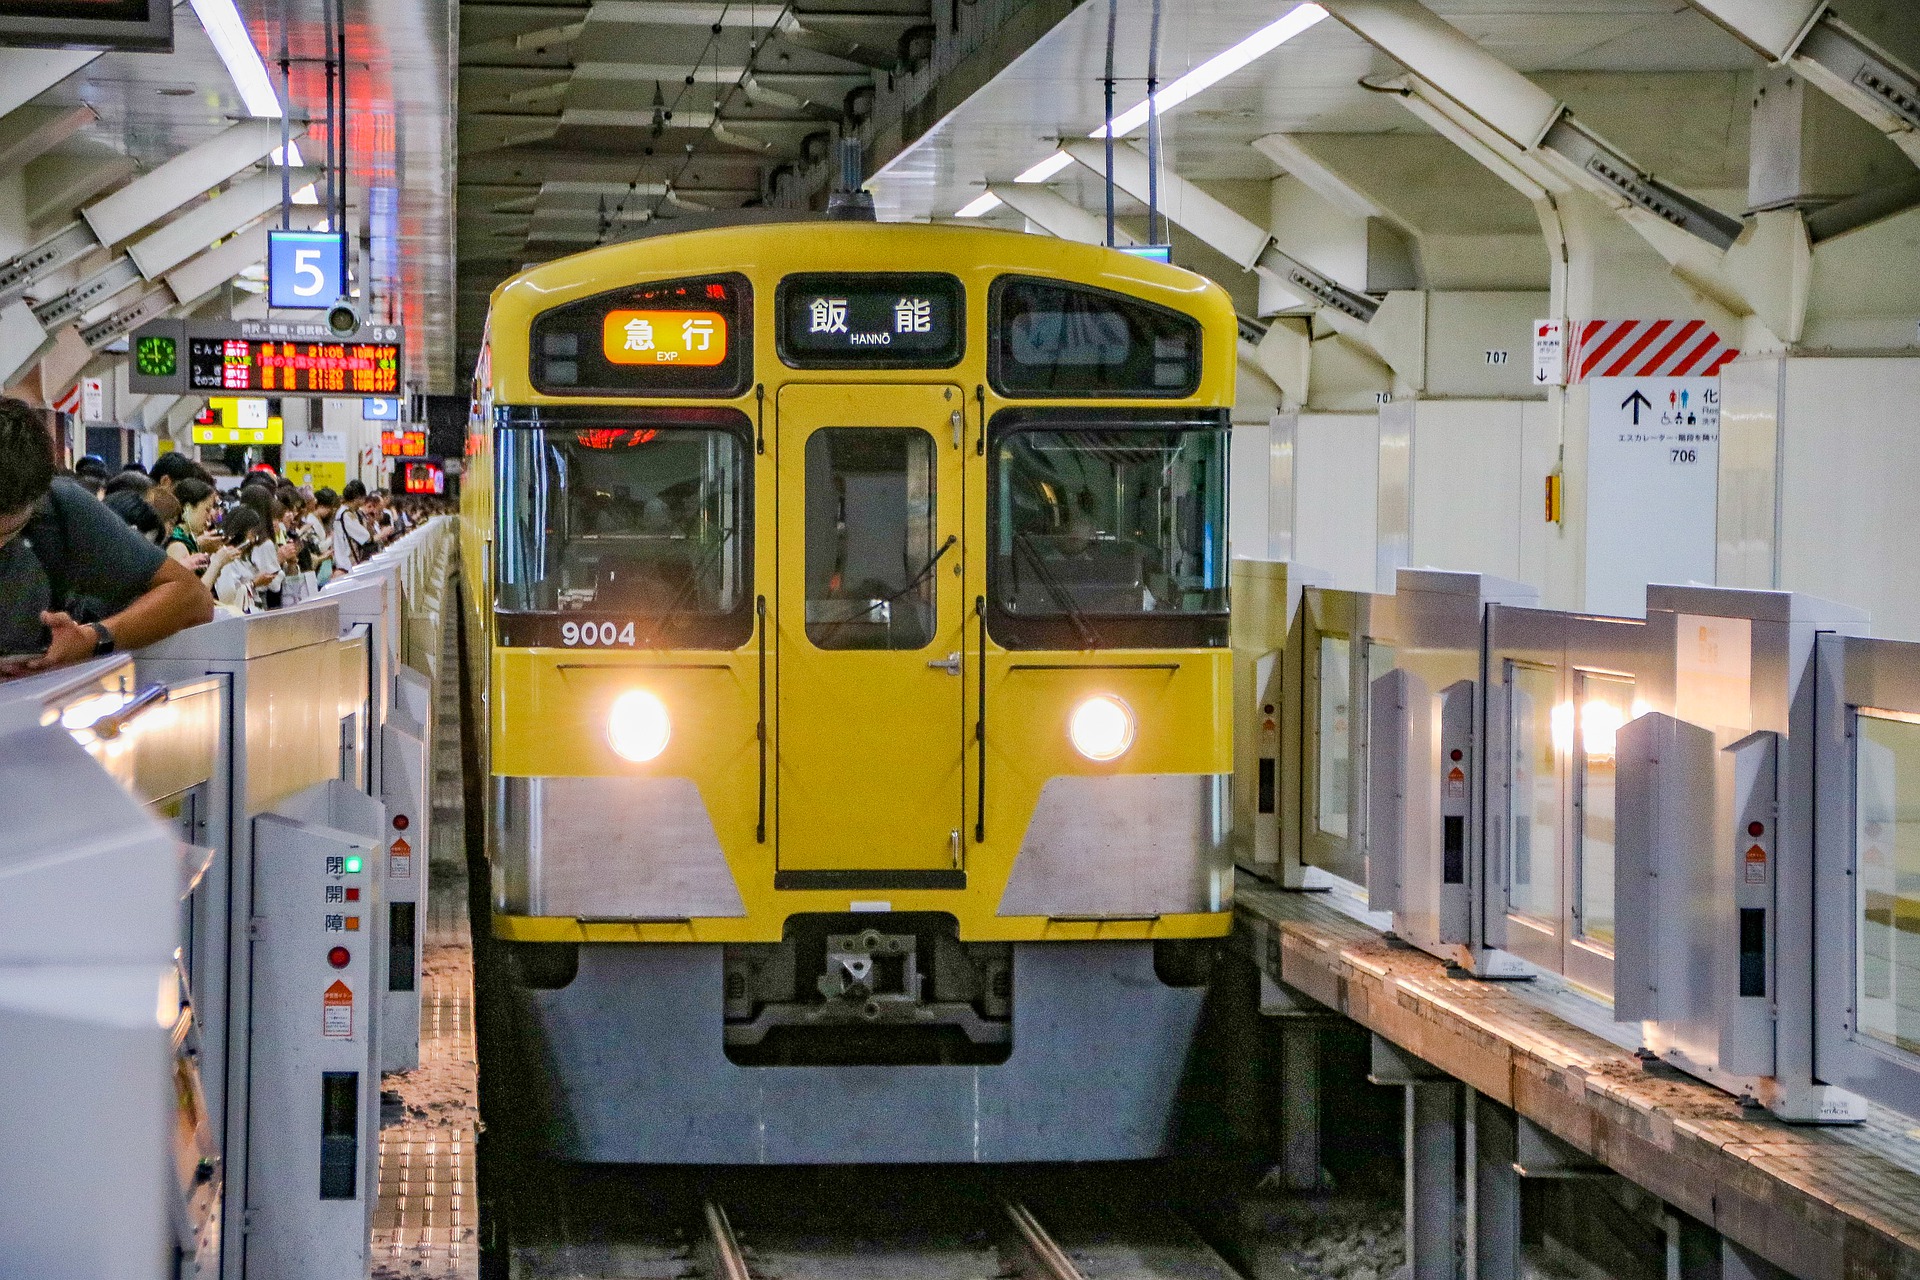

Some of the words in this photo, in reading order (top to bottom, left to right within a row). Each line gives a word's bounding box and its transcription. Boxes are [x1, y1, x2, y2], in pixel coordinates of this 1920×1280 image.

[293, 249, 325, 296] 5
[810, 299, 931, 333] 飯能
[373, 328, 383, 341] 5
[623, 318, 714, 351] 急行
[1486, 351, 1507, 364] 707
[1672, 450, 1696, 463] 706
[562, 621, 636, 646] 9004
[325, 856, 344, 875] 閉
[325, 885, 343, 904] 開
[325, 914, 343, 932] 障
